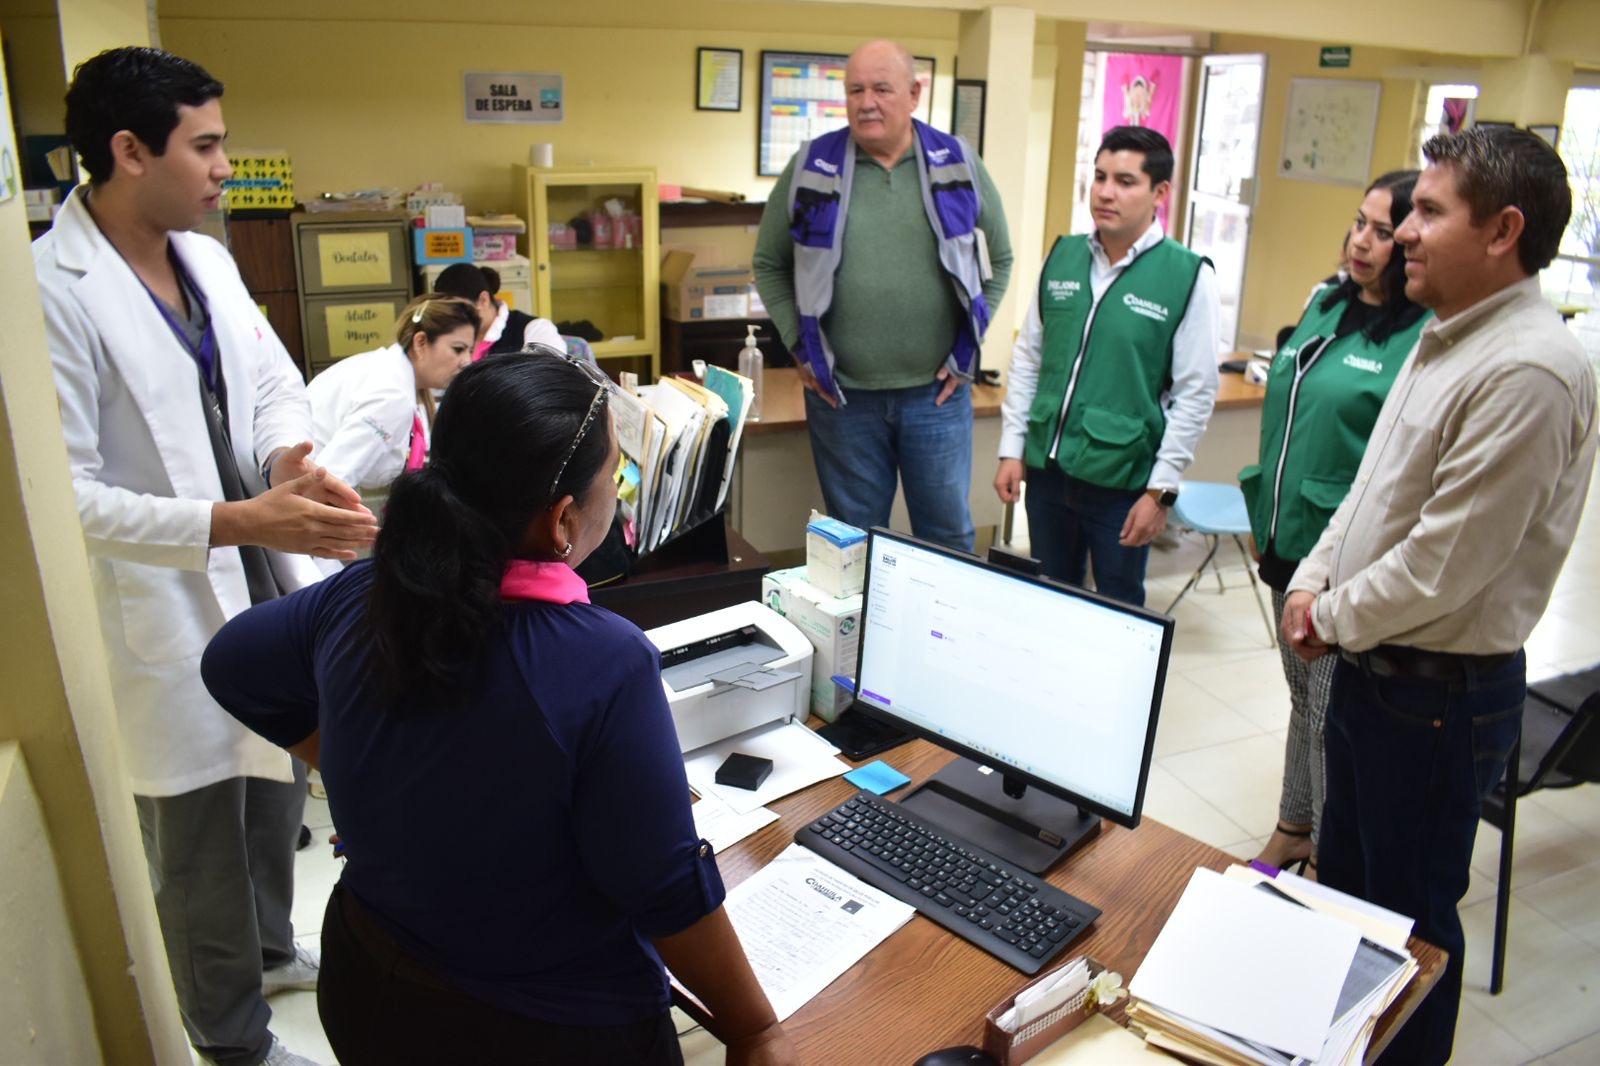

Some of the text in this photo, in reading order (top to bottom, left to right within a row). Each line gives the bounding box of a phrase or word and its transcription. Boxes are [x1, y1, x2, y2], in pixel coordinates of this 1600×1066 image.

[489, 84, 518, 97] SALA
[475, 98, 489, 112] DE
[491, 99, 533, 112] ESPERA
[332, 250, 379, 264] Dentales
